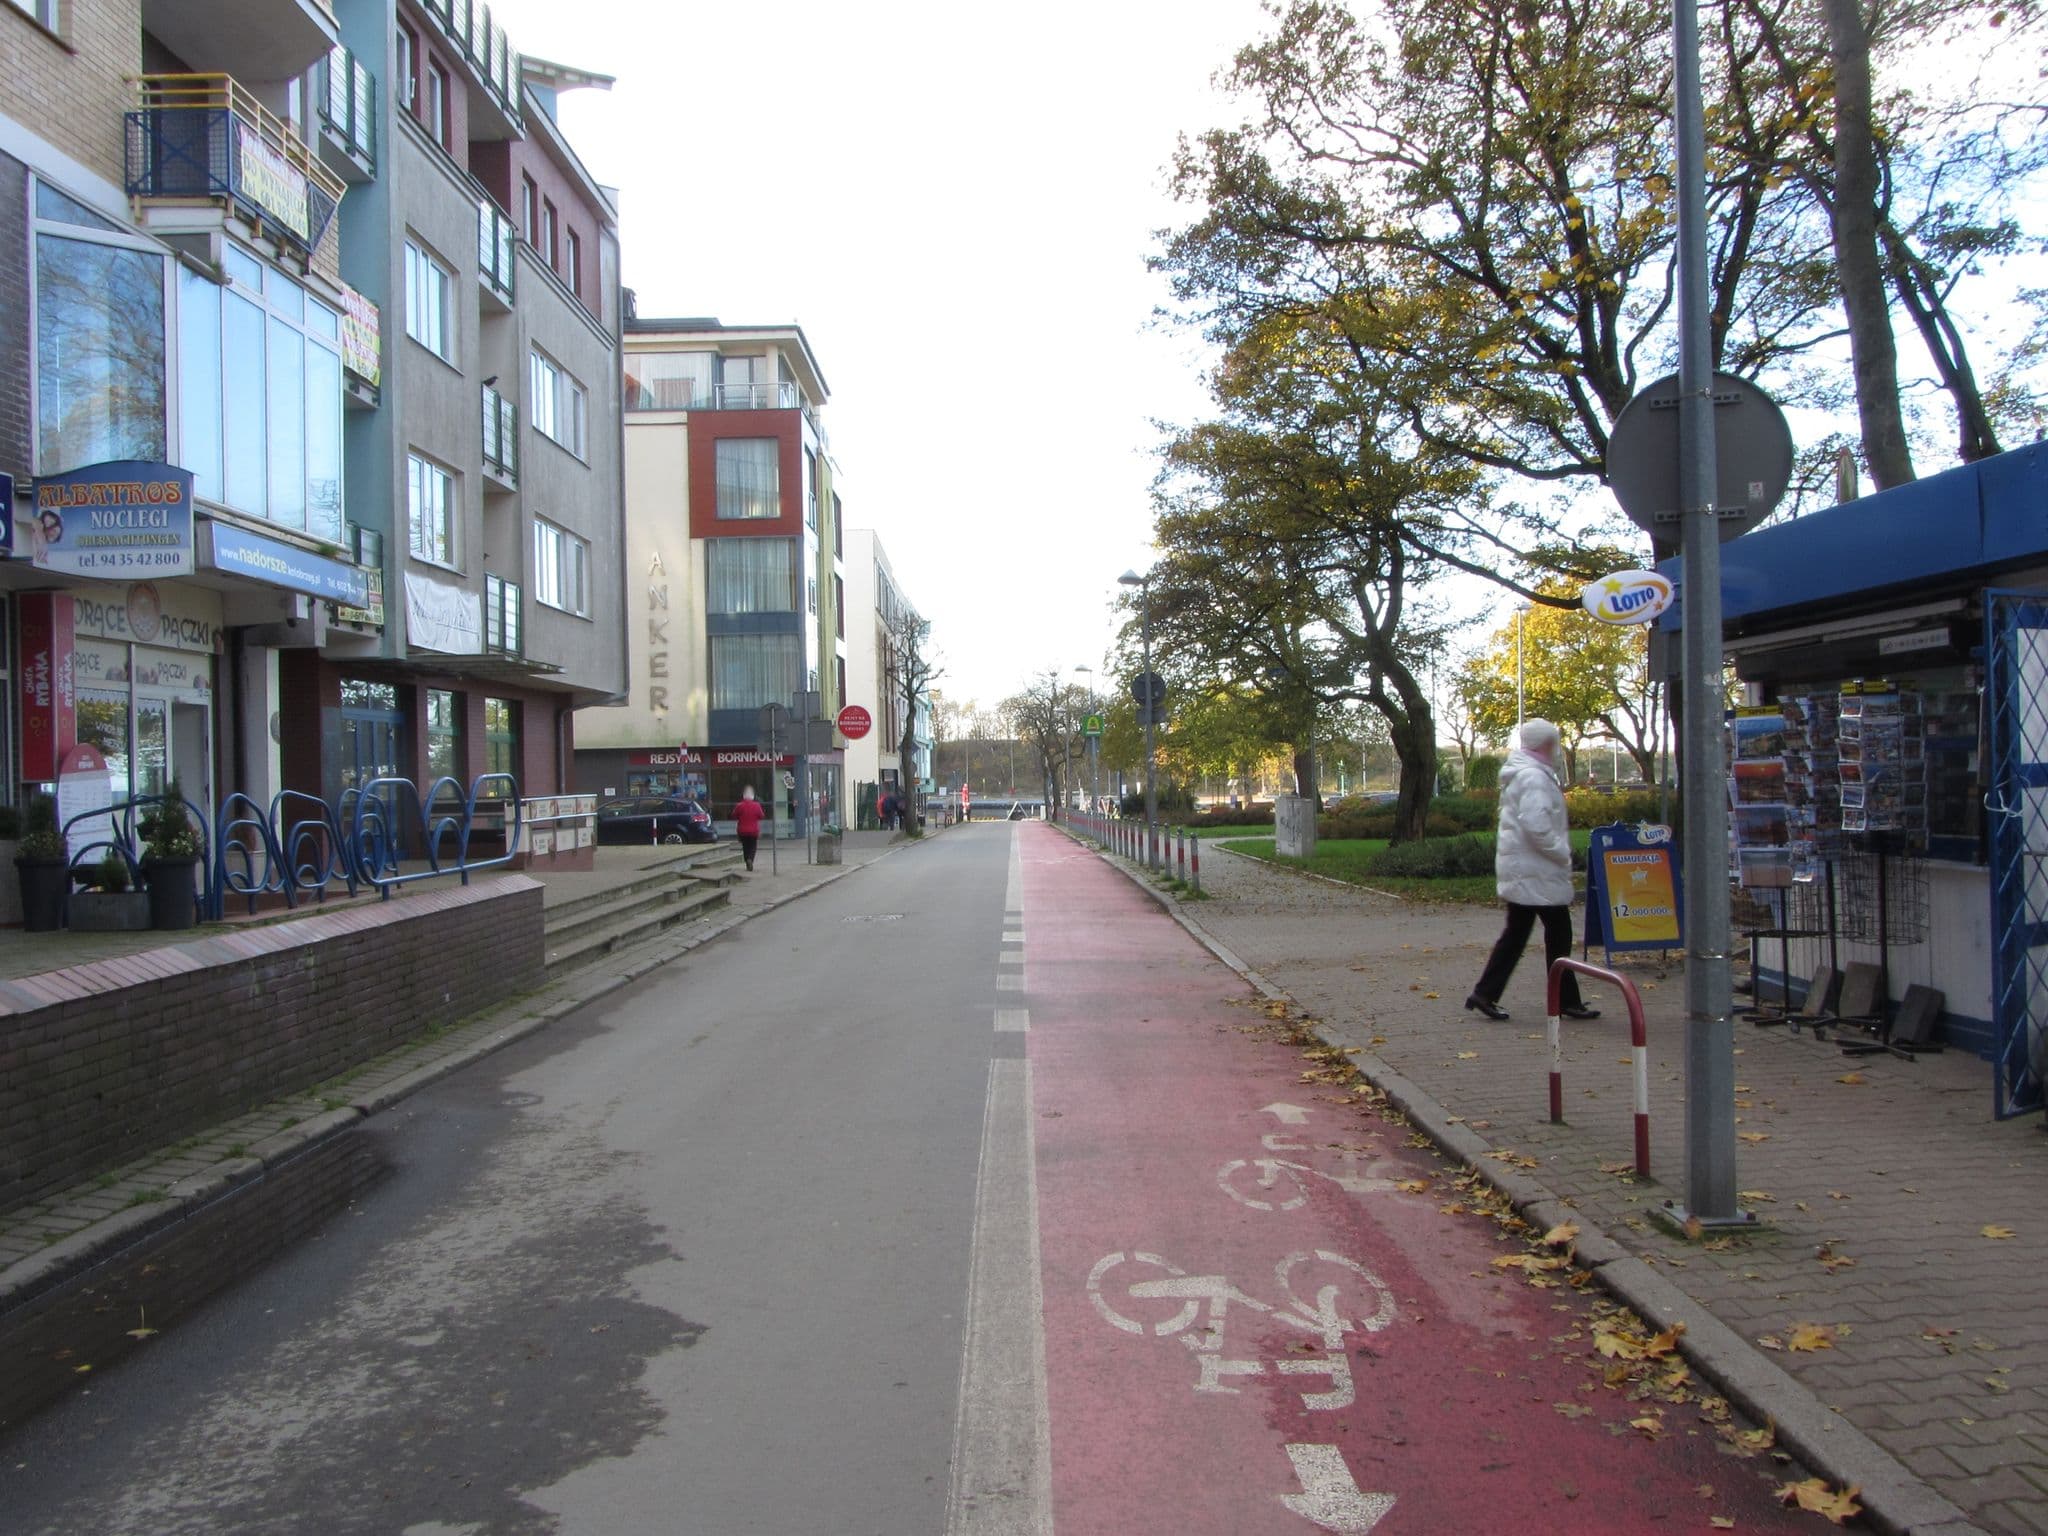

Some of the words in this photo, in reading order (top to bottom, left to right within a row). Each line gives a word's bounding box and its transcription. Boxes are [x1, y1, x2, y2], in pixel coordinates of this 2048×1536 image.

[38, 481, 183, 508] ALBATROS
[90, 508, 170, 530] NOCLEGI
[79, 554, 98, 568] tel.
[101, 554, 117, 567] 94
[119, 554, 134, 566] 35
[136, 553, 153, 566] 42
[155, 552, 181, 565] 800
[1611, 587, 1655, 612] LOTTO
[160, 614, 209, 648] PĄCZKI
[648, 551, 669, 711] ANKER
[34, 650, 50, 707] RYBAKA
[157, 661, 188, 682] PĄCZKI
[650, 752, 682, 764] REJSY
[686, 752, 701, 764] NA
[717, 751, 784, 763] BORNHOLM
[1644, 828, 1666, 840] LOTTO
[1612, 853, 1662, 864] KUMULACJA
[1613, 904, 1630, 918] 12
